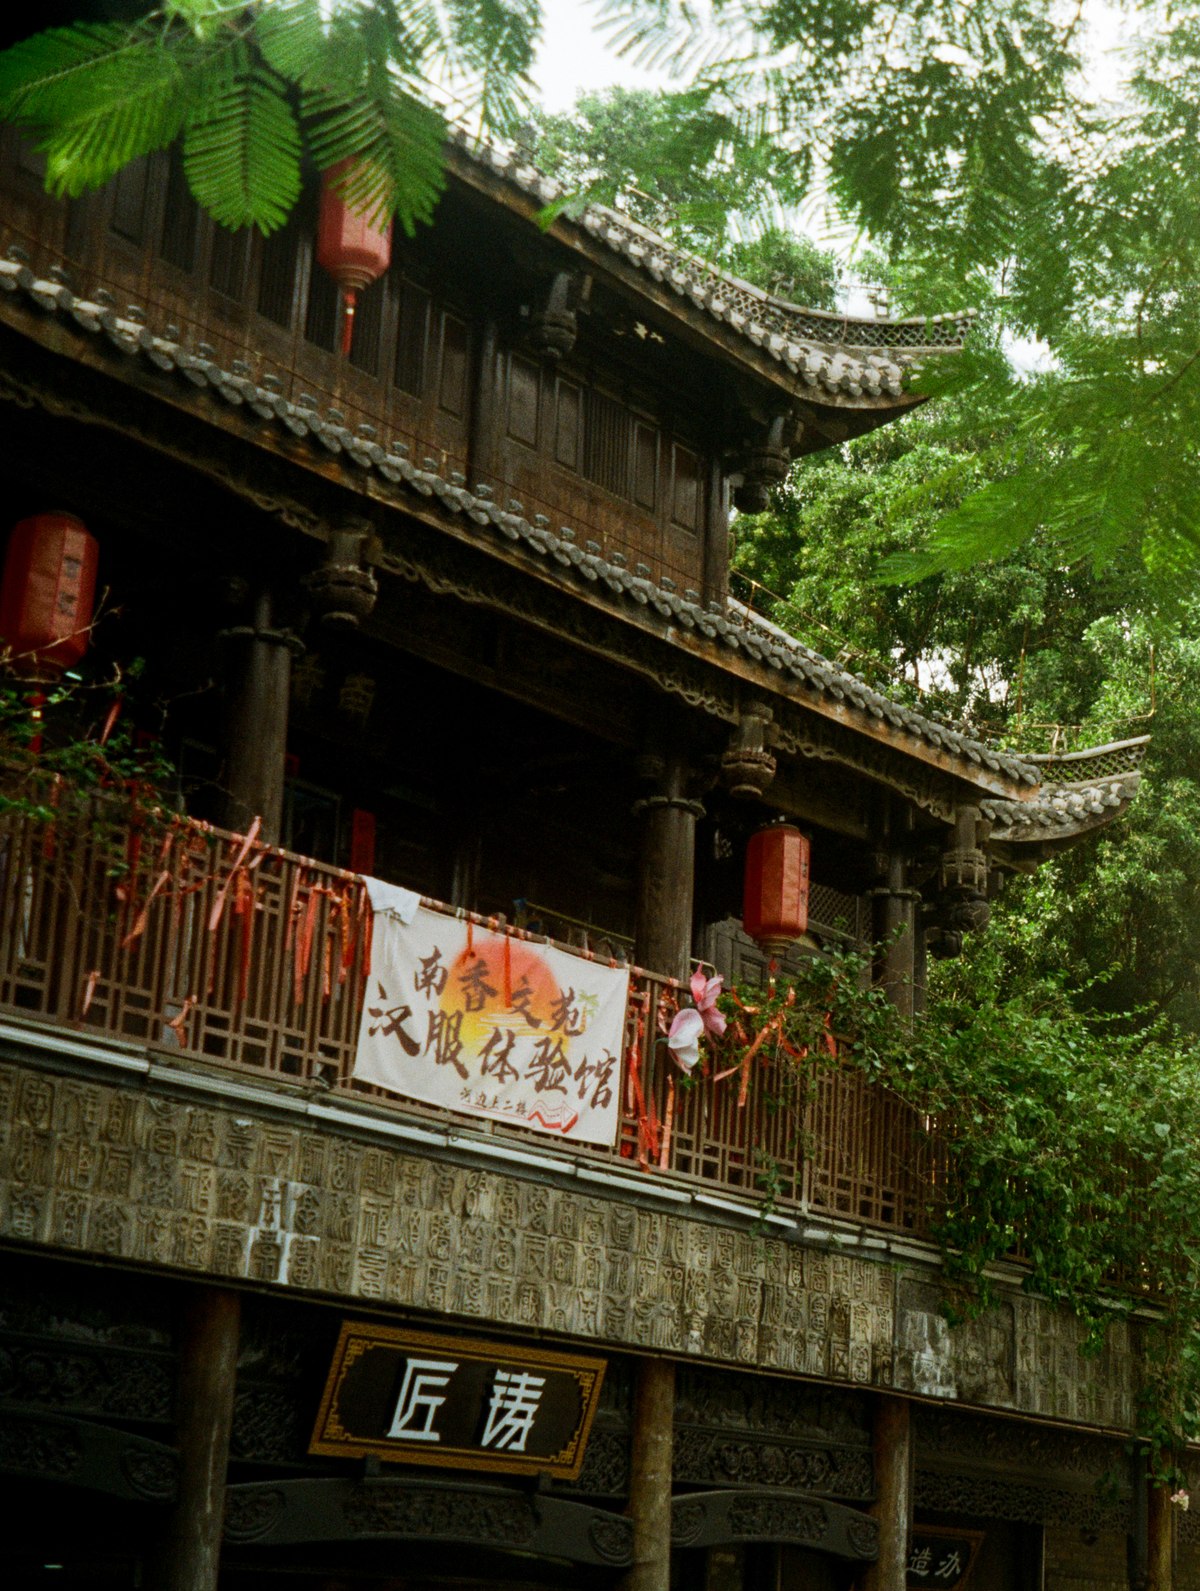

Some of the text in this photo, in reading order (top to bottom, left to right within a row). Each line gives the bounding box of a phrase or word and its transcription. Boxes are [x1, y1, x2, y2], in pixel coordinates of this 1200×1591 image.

[367, 980, 618, 1110] 汉服体验馆
[413, 945, 583, 1038] 南香文苑
